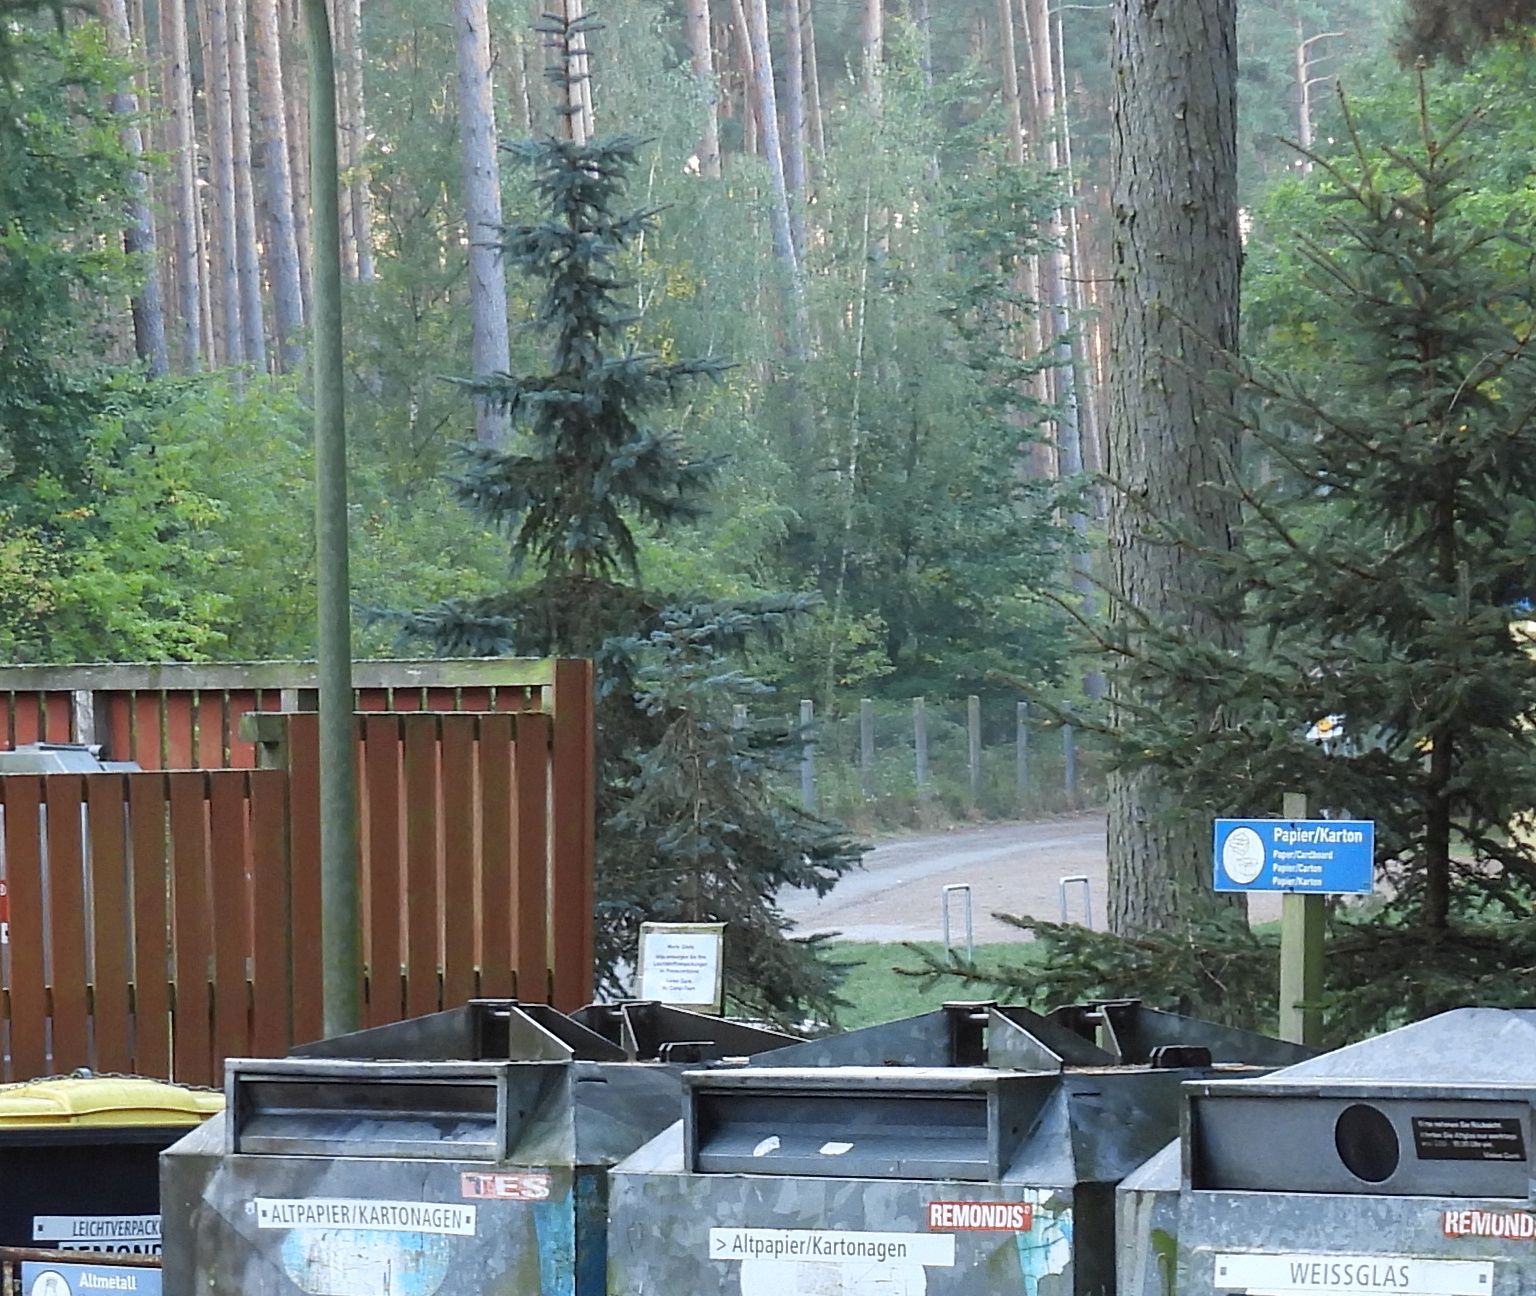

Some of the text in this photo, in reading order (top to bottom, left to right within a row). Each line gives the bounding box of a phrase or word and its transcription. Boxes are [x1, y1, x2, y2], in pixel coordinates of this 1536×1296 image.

[1274, 826, 1363, 845] Papier/Karton
[272, 1204, 462, 1228] ALTPAPIER/KARTONAGEN
[73, 1219, 162, 1236] LEICHTVERPACK
[732, 1233, 907, 1262] Altpapier/Kartonagen
[79, 1272, 137, 1290] Altmetall
[1290, 1262, 1410, 1288] WEISSGLAS
